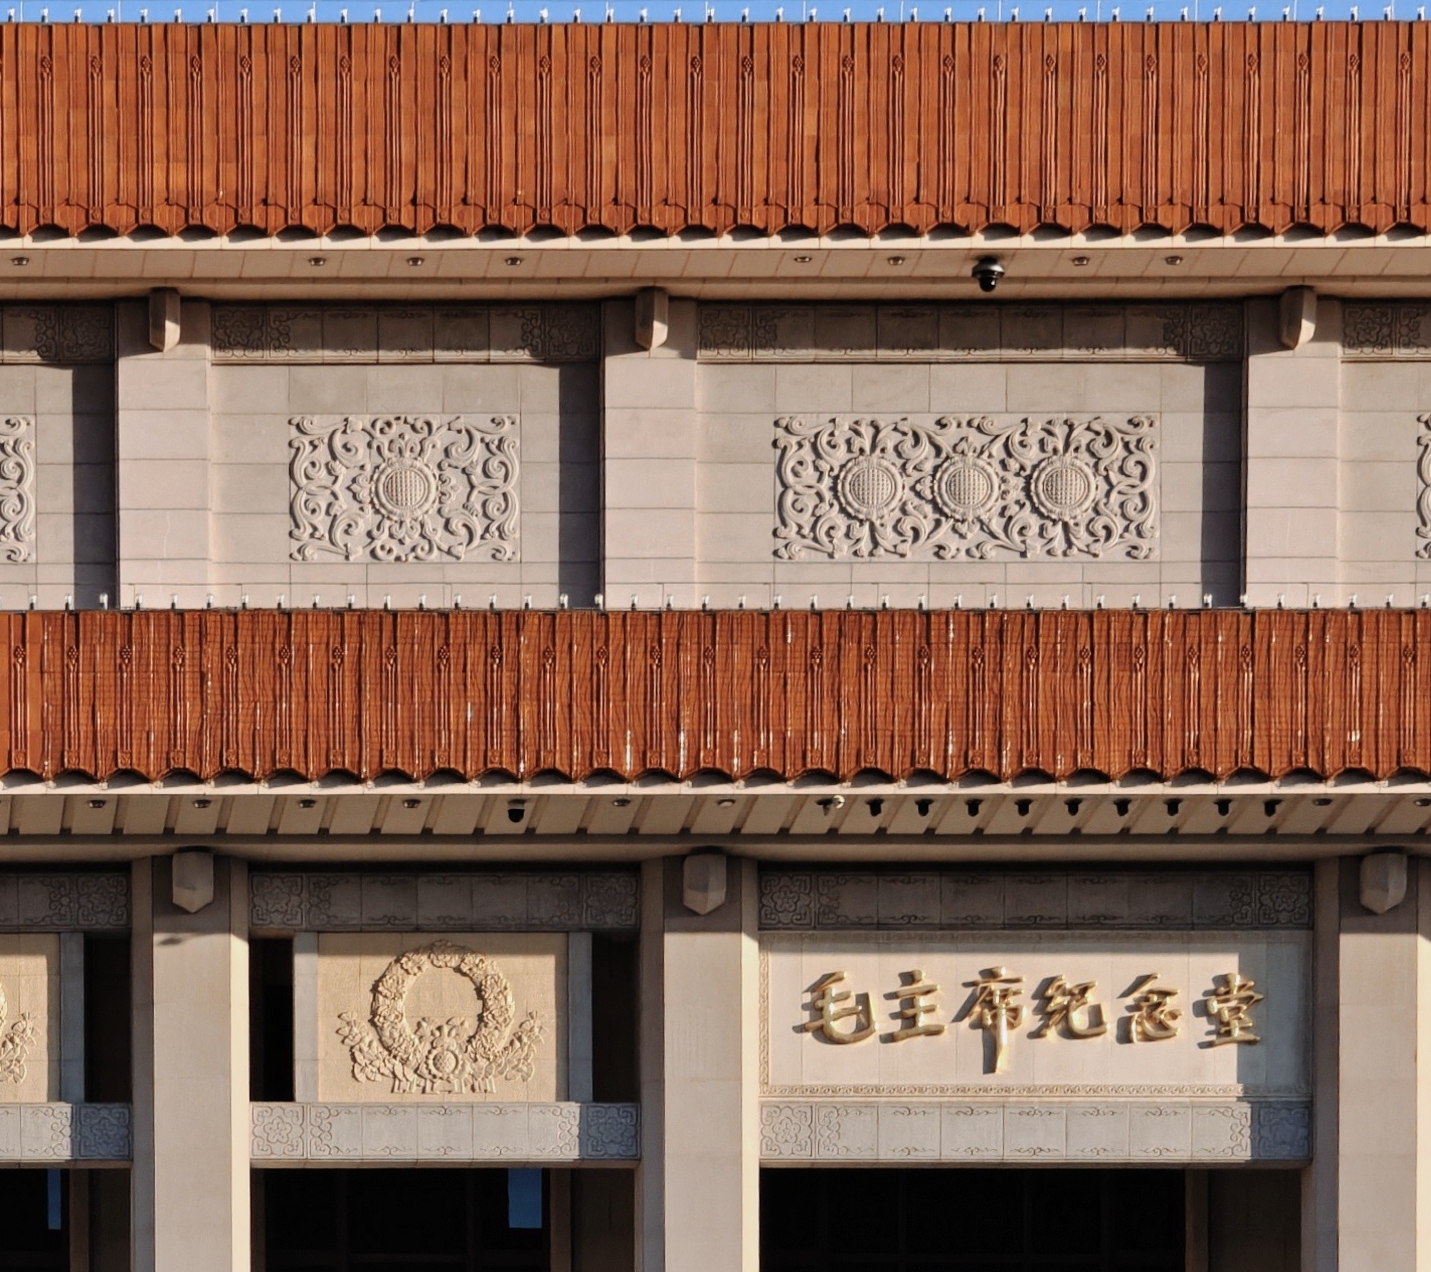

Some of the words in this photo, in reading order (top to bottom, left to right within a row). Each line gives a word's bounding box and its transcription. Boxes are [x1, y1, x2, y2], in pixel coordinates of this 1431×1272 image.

[801, 966, 1264, 1073] 毛主席纪念堂
